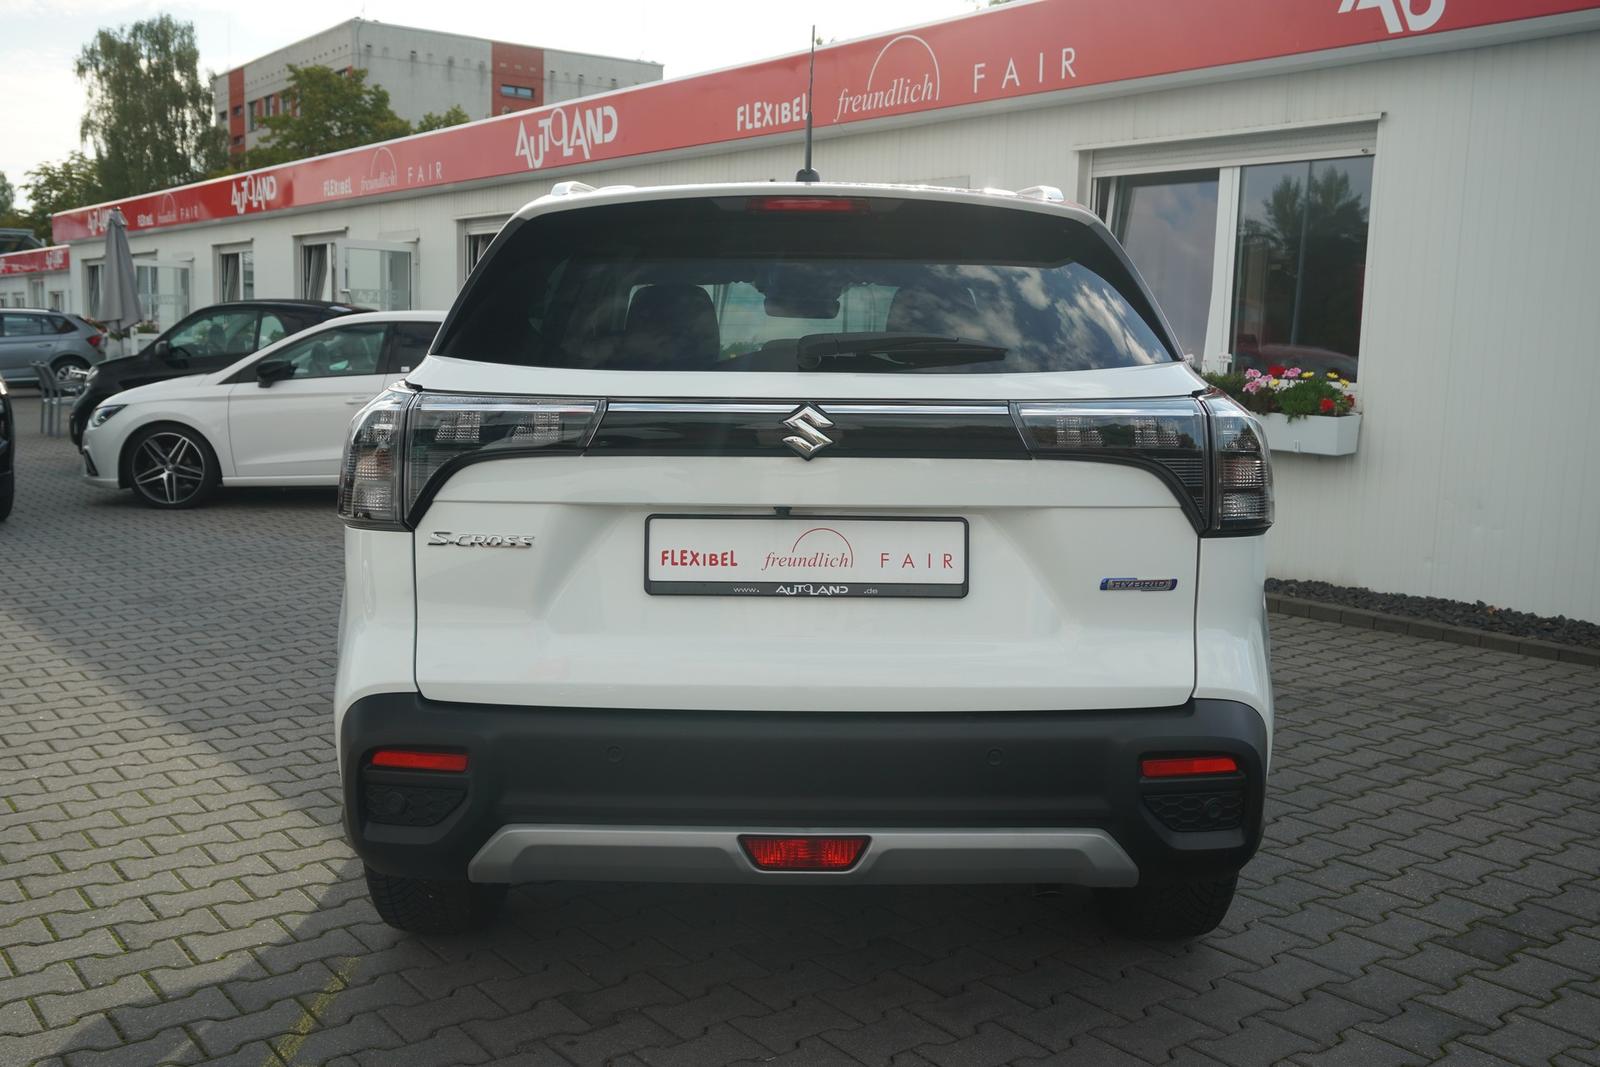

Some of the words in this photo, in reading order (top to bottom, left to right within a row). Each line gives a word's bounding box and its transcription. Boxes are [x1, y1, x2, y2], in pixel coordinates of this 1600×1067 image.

[736, 92, 808, 132] FLEXIBEL
[833, 73, 933, 123] freundlich
[973, 47, 1076, 93] FAIR
[515, 105, 618, 169] AUTOLAND
[408, 161, 443, 183] FAIR
[661, 550, 738, 567] FLEXIBEL
[761, 551, 849, 571] freundlich
[880, 553, 953, 569] FAIR
[775, 584, 849, 595] AUTOLAND
